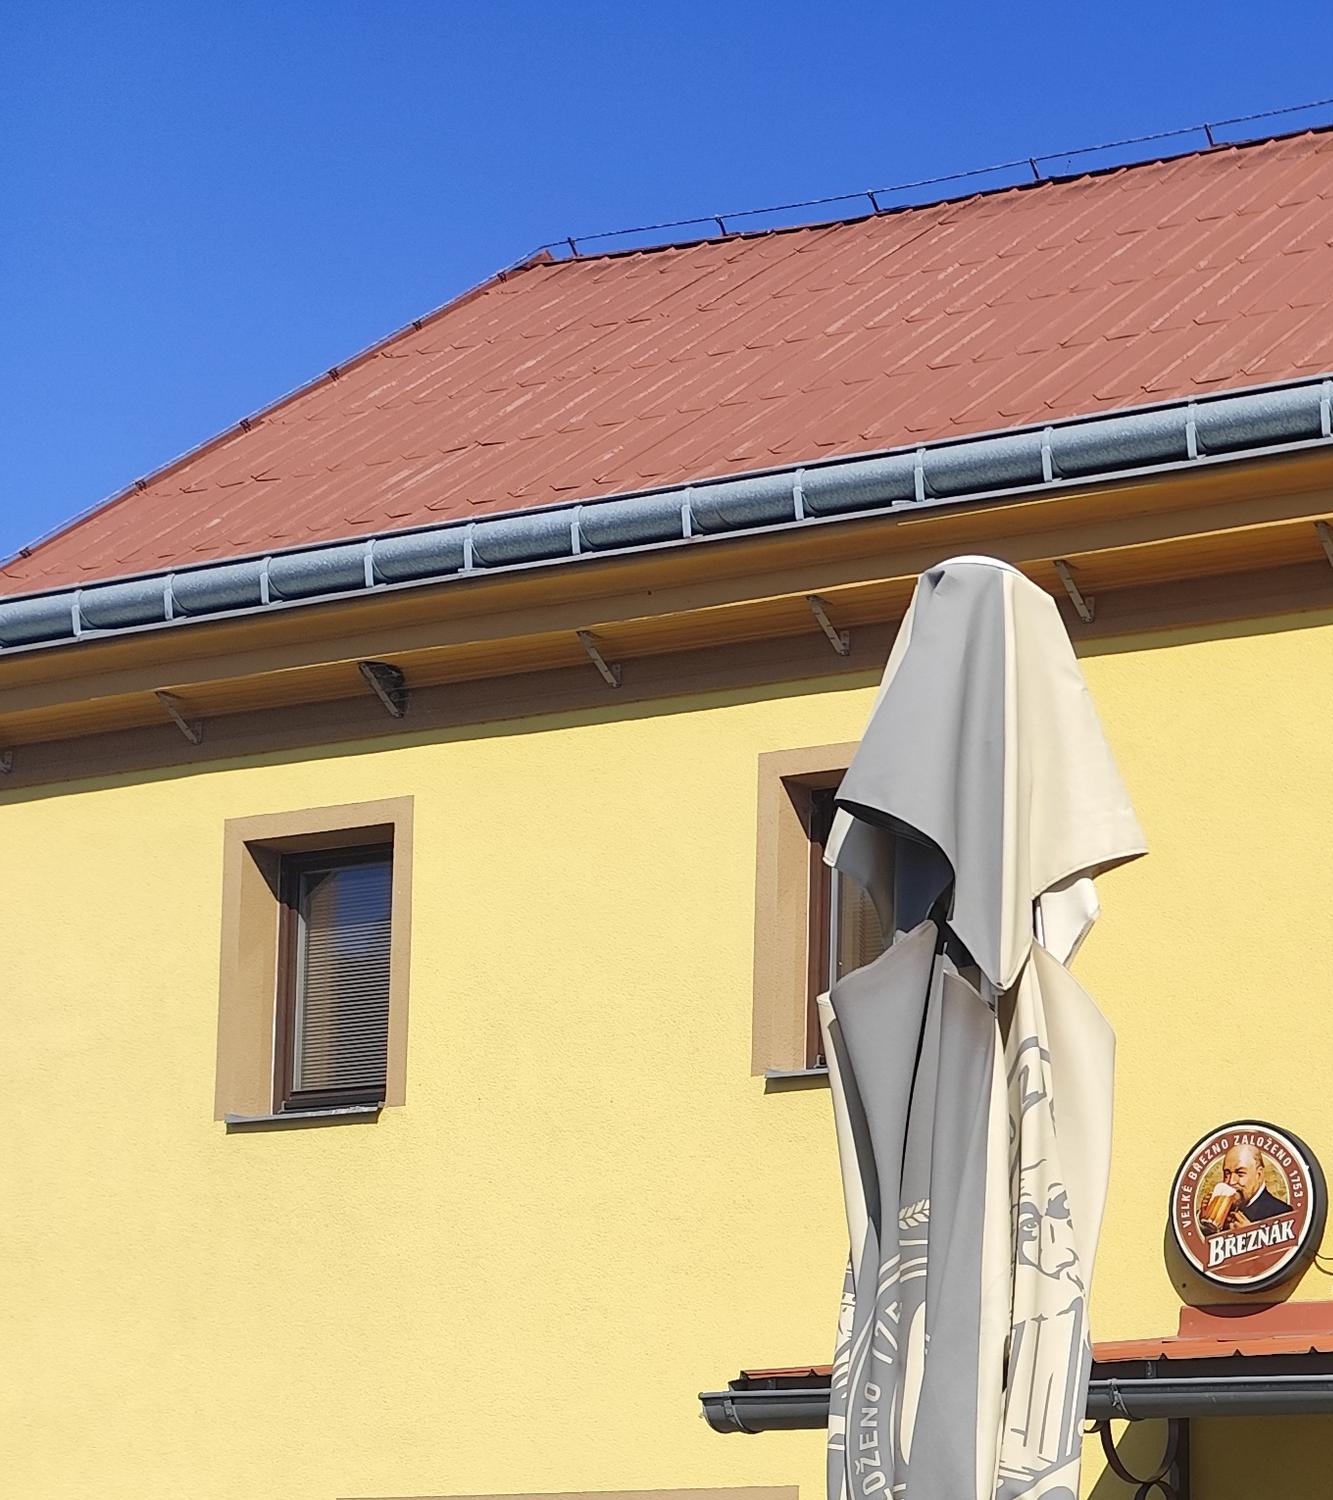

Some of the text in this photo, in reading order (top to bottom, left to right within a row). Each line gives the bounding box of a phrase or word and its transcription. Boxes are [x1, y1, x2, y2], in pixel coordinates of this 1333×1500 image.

[1181, 1134, 1304, 1228] VELKÉ BŘEZNO ZALOŽENO 1753
[1208, 1219, 1296, 1267] BŘEZŇÁK
